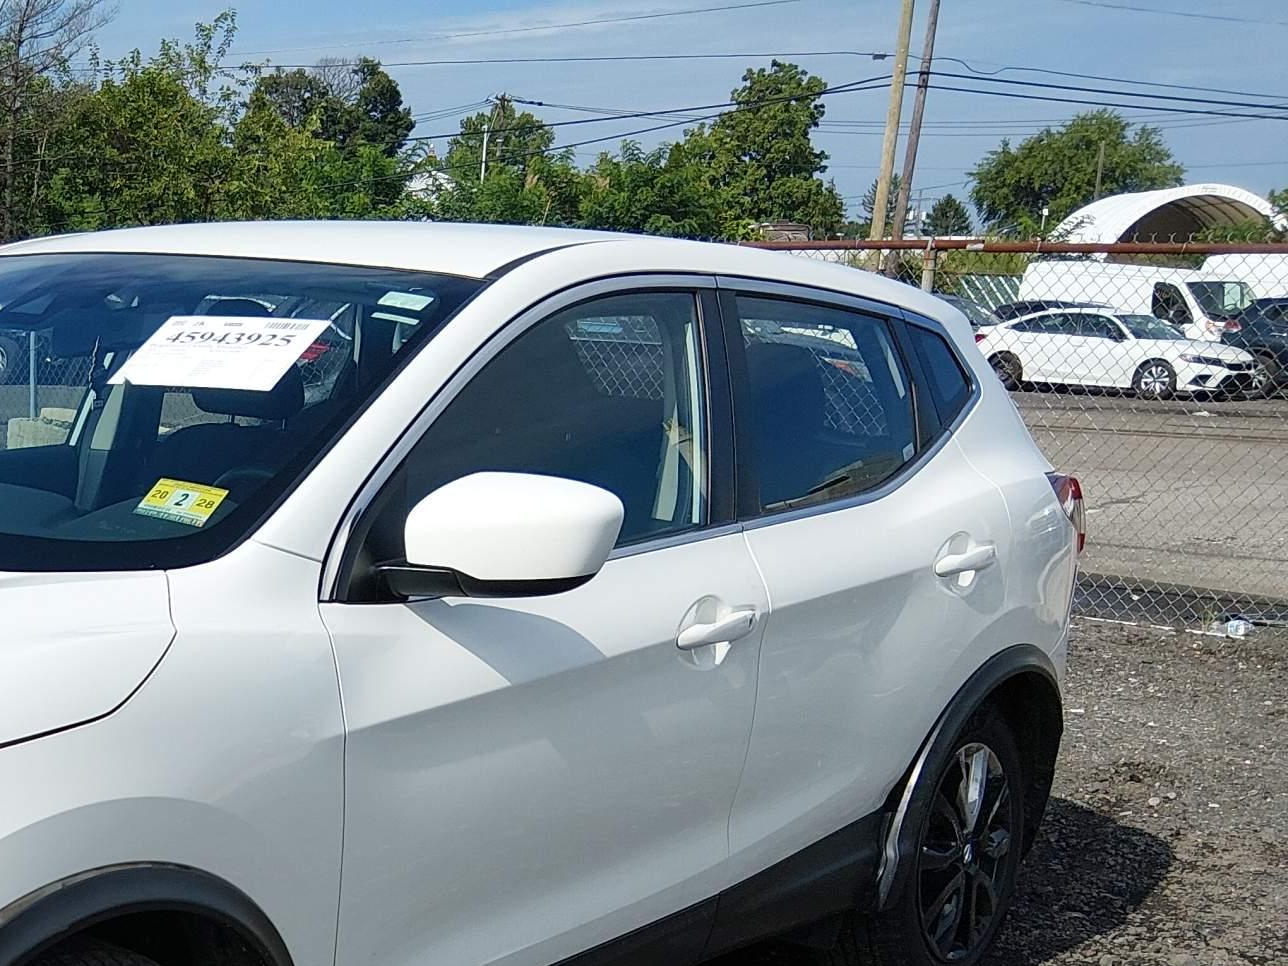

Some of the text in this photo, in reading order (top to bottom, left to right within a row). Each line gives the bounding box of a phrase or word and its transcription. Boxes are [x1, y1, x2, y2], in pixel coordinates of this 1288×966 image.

[165, 330, 297, 347] 45943925
[151, 489, 215, 509] 20 2 28
